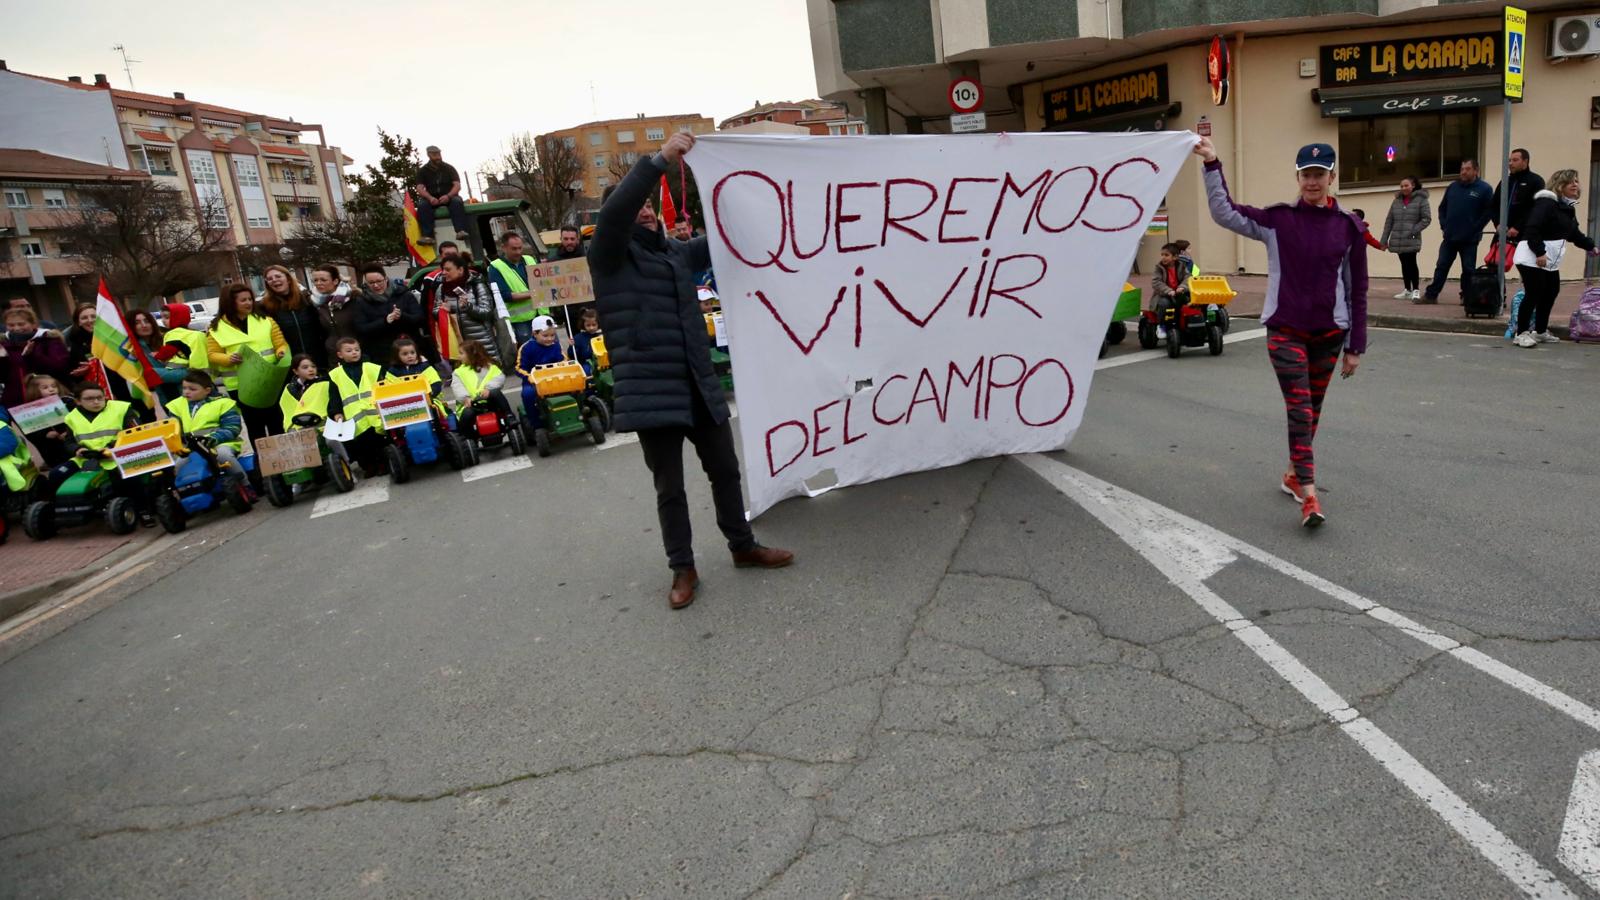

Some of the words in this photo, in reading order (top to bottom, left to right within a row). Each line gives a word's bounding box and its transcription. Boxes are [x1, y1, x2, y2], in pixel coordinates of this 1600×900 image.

[1333, 47, 1360, 62] CAFE
[1336, 66, 1357, 82] BAR
[1371, 45, 1397, 75] LA
[1403, 36, 1495, 71] CERRADA
[1074, 86, 1092, 113] LA
[1095, 71, 1159, 107] CERRADA
[1383, 97, 1430, 110] Café
[1442, 94, 1481, 106] Bar
[712, 156, 1160, 273] QUEREMOS
[754, 248, 1048, 355] VIVIR
[765, 398, 868, 477] DEL
[871, 354, 1075, 428] CAMPO
